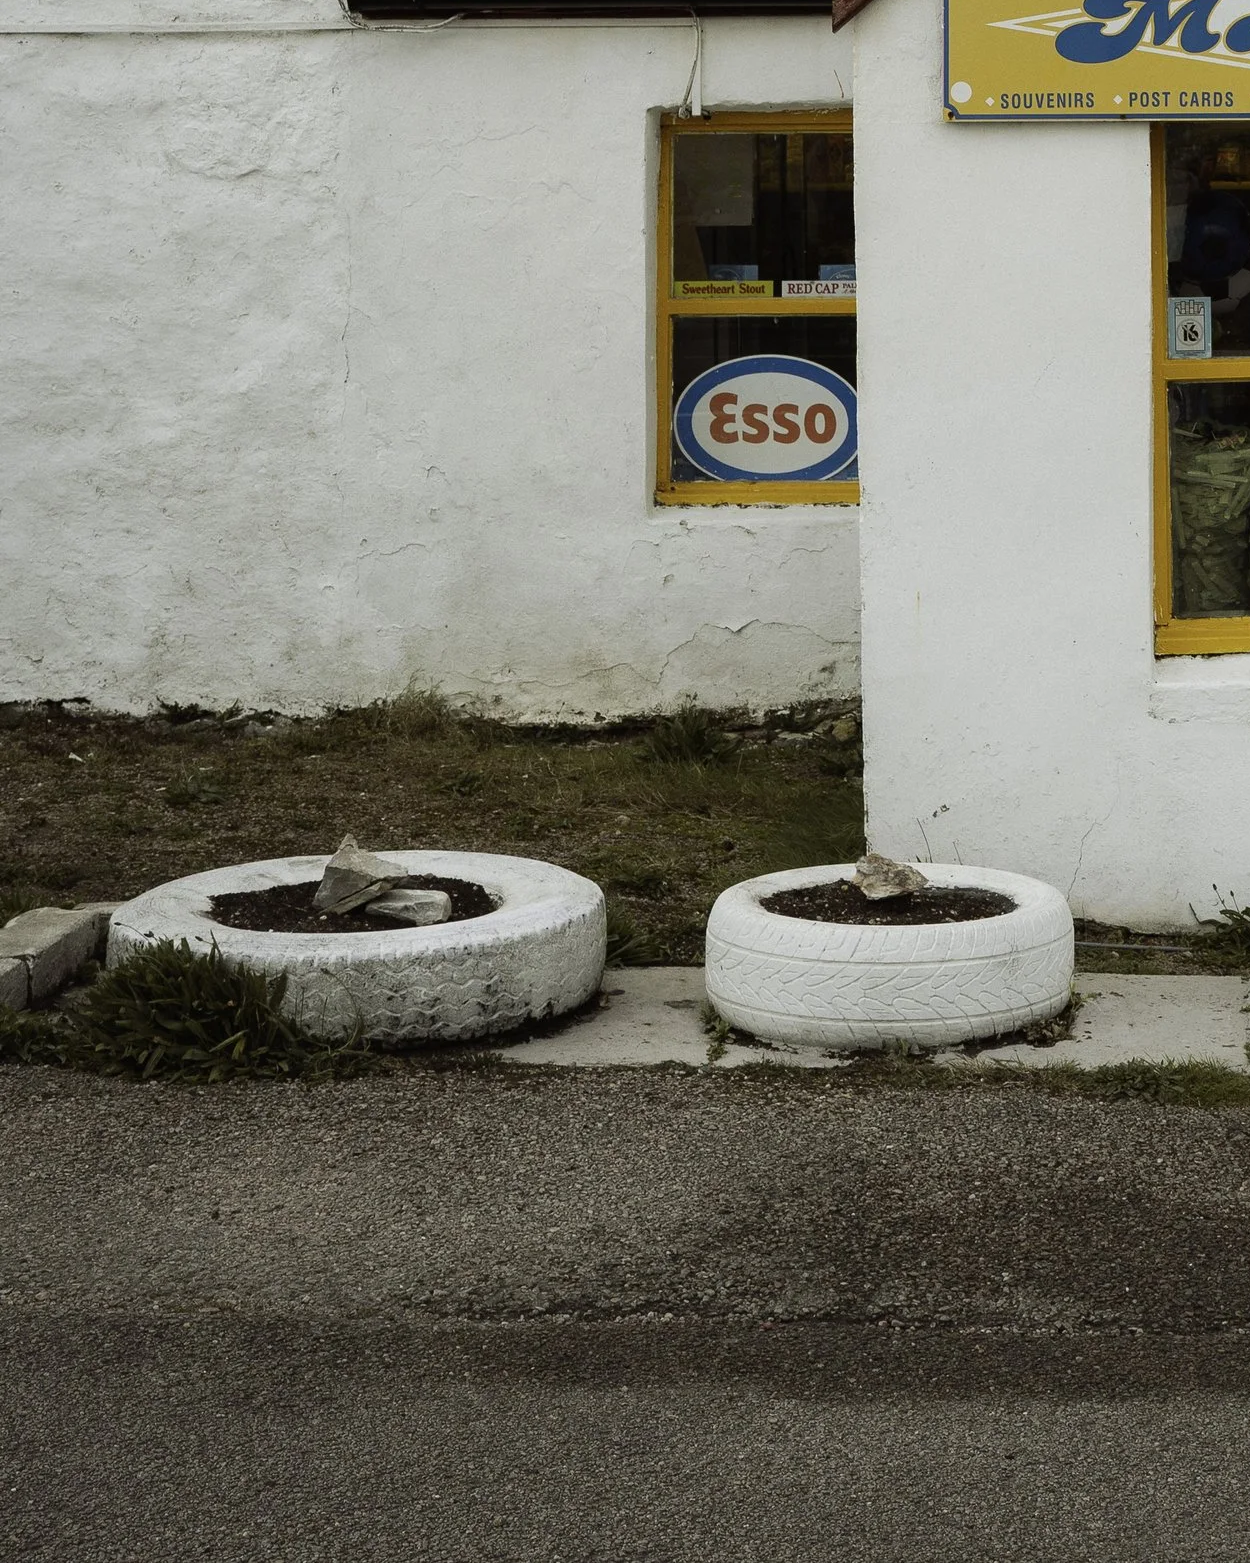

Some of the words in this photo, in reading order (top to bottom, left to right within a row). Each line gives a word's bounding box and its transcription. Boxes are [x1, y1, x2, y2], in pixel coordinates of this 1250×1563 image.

[1000, 92, 1096, 109] SOUVENIRS
[1128, 91, 1173, 108] POST
[1179, 91, 1235, 108] CARDS
[682, 283, 735, 295] Sweetheart
[739, 283, 765, 294] Stout
[788, 283, 812, 294] RED
[815, 283, 839, 294] CAP
